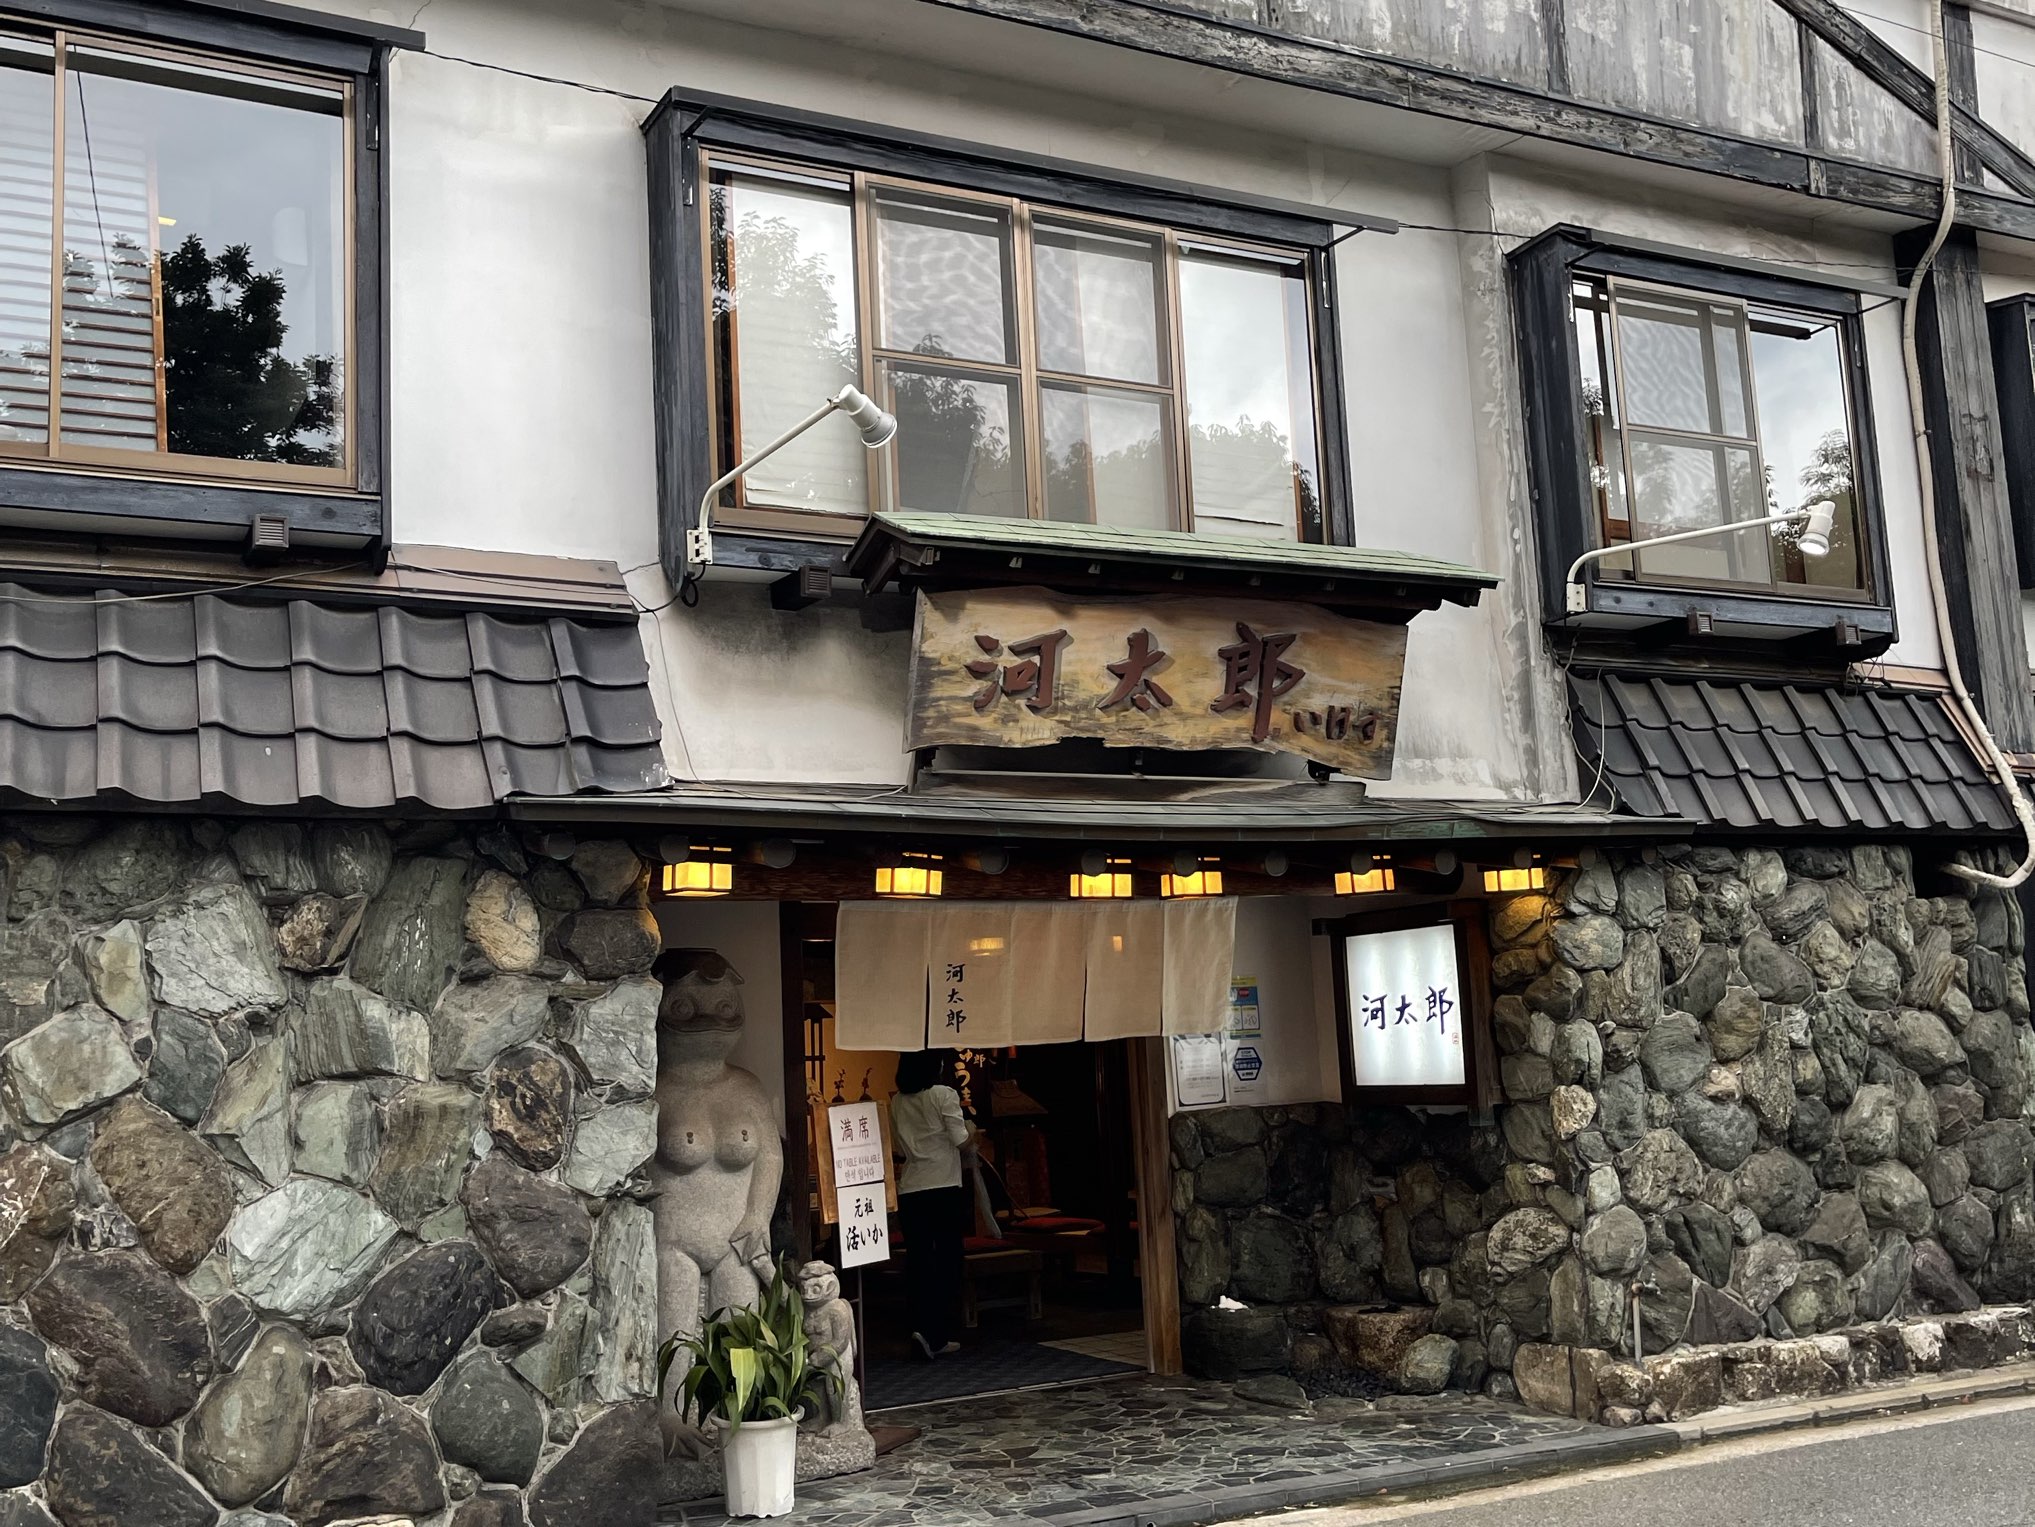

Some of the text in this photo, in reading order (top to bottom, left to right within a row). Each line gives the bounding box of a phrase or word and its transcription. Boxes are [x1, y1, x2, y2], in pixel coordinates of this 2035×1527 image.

[963, 622, 1305, 743] 河太郎
[945, 963, 967, 1033] 河太郎
[1362, 986, 1454, 1034] 河太郎
[840, 1115, 869, 1142] 満席
[844, 1156, 857, 1168] TABLE
[854, 1198, 874, 1218] 元祖
[845, 1223, 884, 1252] 活いか
